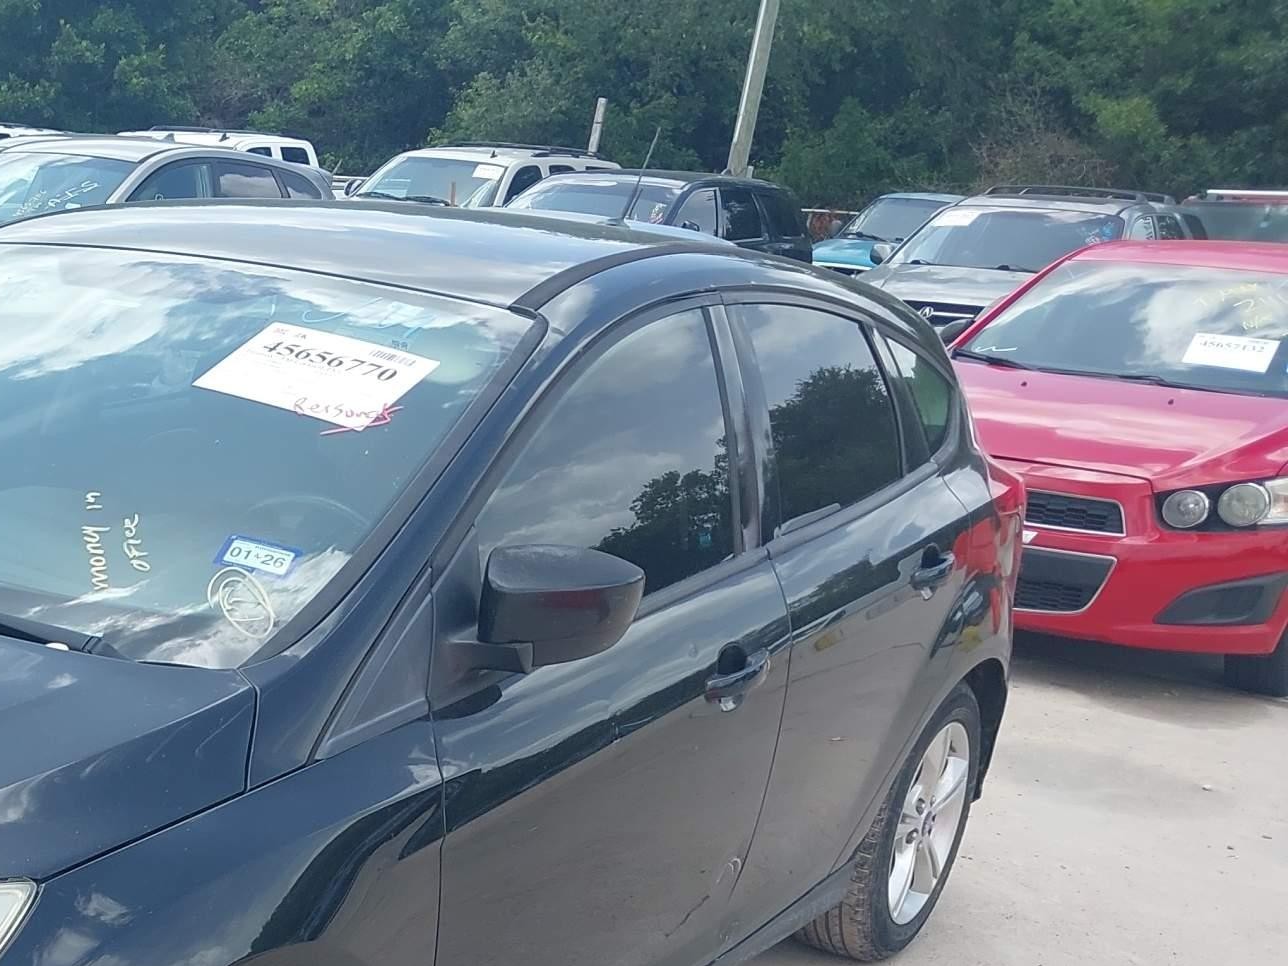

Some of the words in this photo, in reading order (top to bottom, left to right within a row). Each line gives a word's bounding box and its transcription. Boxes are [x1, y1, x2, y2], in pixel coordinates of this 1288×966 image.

[263, 341, 398, 382] 45656770
[229, 546, 253, 560] 01
[260, 554, 286, 569] 26
